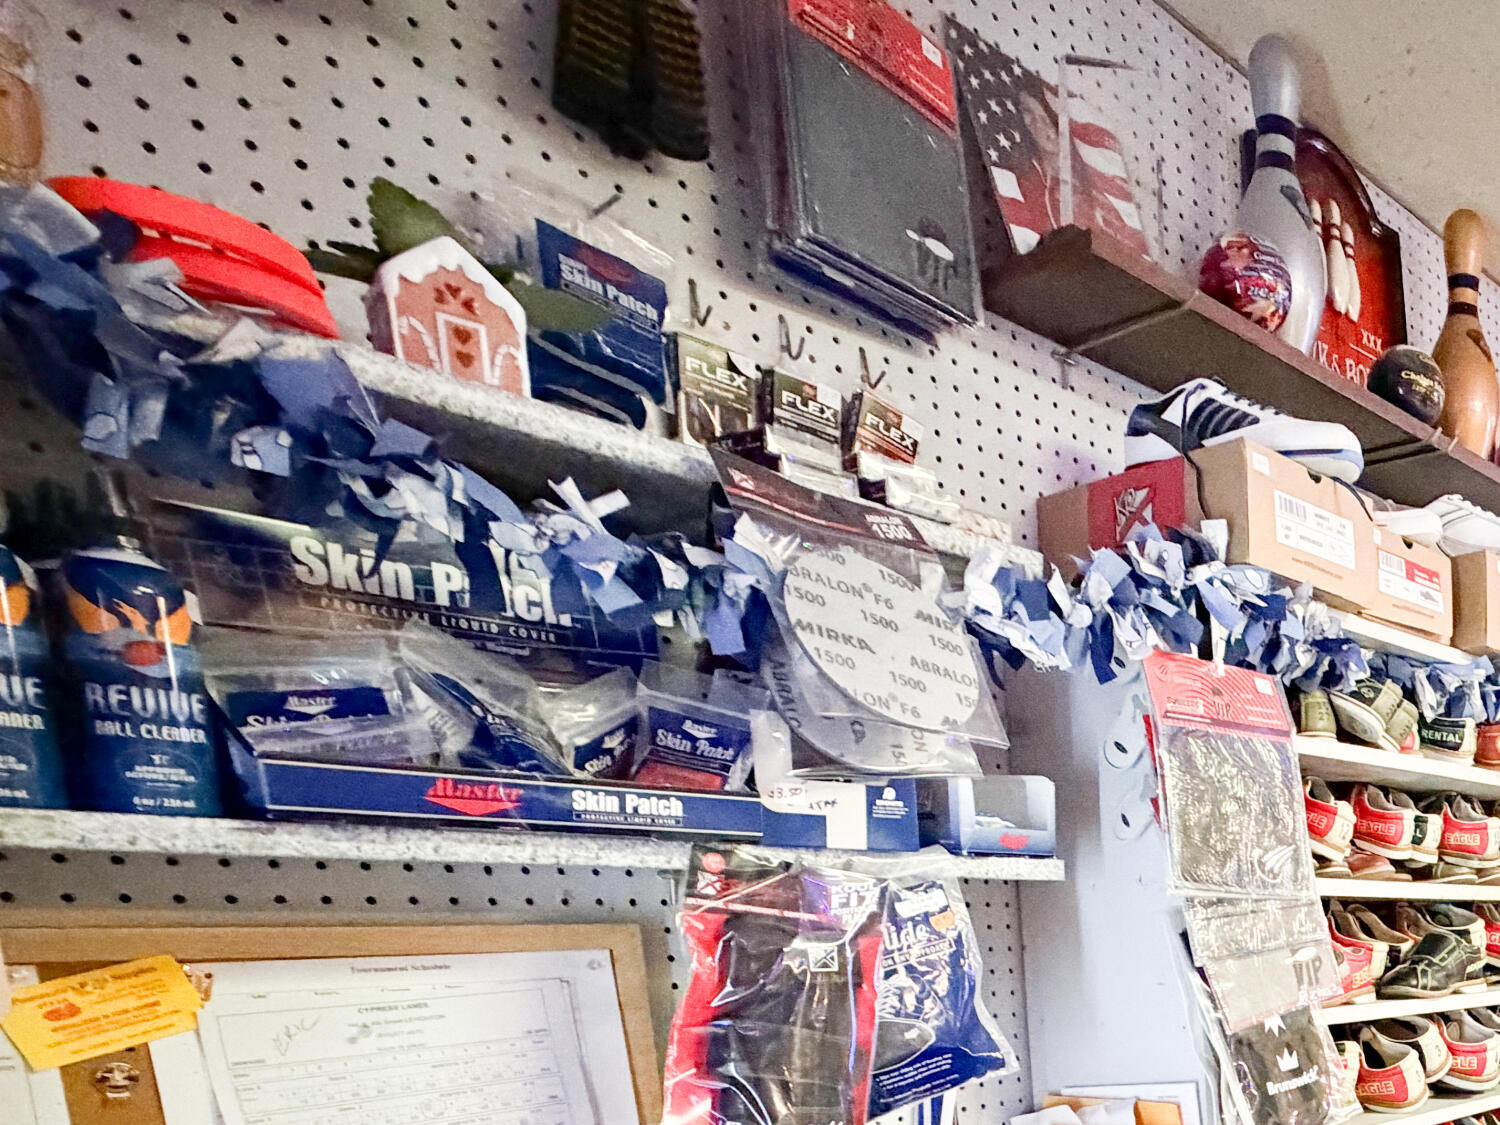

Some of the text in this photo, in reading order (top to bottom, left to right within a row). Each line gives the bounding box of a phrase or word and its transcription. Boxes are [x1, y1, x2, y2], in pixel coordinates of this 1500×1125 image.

[560, 262, 604, 297] Skin
[605, 283, 659, 322] Patch
[685, 355, 748, 391] FLEX
[781, 390, 837, 422] FLEX
[865, 412, 918, 451] FLEX
[872, 521, 913, 541] 1500
[290, 535, 415, 601] Skin
[786, 584, 826, 608] 1500
[441, 615, 500, 635] LIQUID
[508, 626, 557, 644] COVER
[860, 609, 899, 633] 1500
[793, 617, 876, 655] MIRKA
[928, 633, 964, 657] 1500
[813, 647, 856, 671] 1500
[888, 670, 927, 693] 1500
[656, 727, 692, 752] Skin
[695, 738, 736, 762] Patch
[1421, 728, 1462, 744] RENTAL
[429, 777, 525, 802] Master
[572, 790, 684, 817] Skin Patch
[1357, 819, 1396, 835] EAGLE
[1445, 832, 1481, 846] EAGLE
[1265, 1064, 1318, 1096] Brunswick
